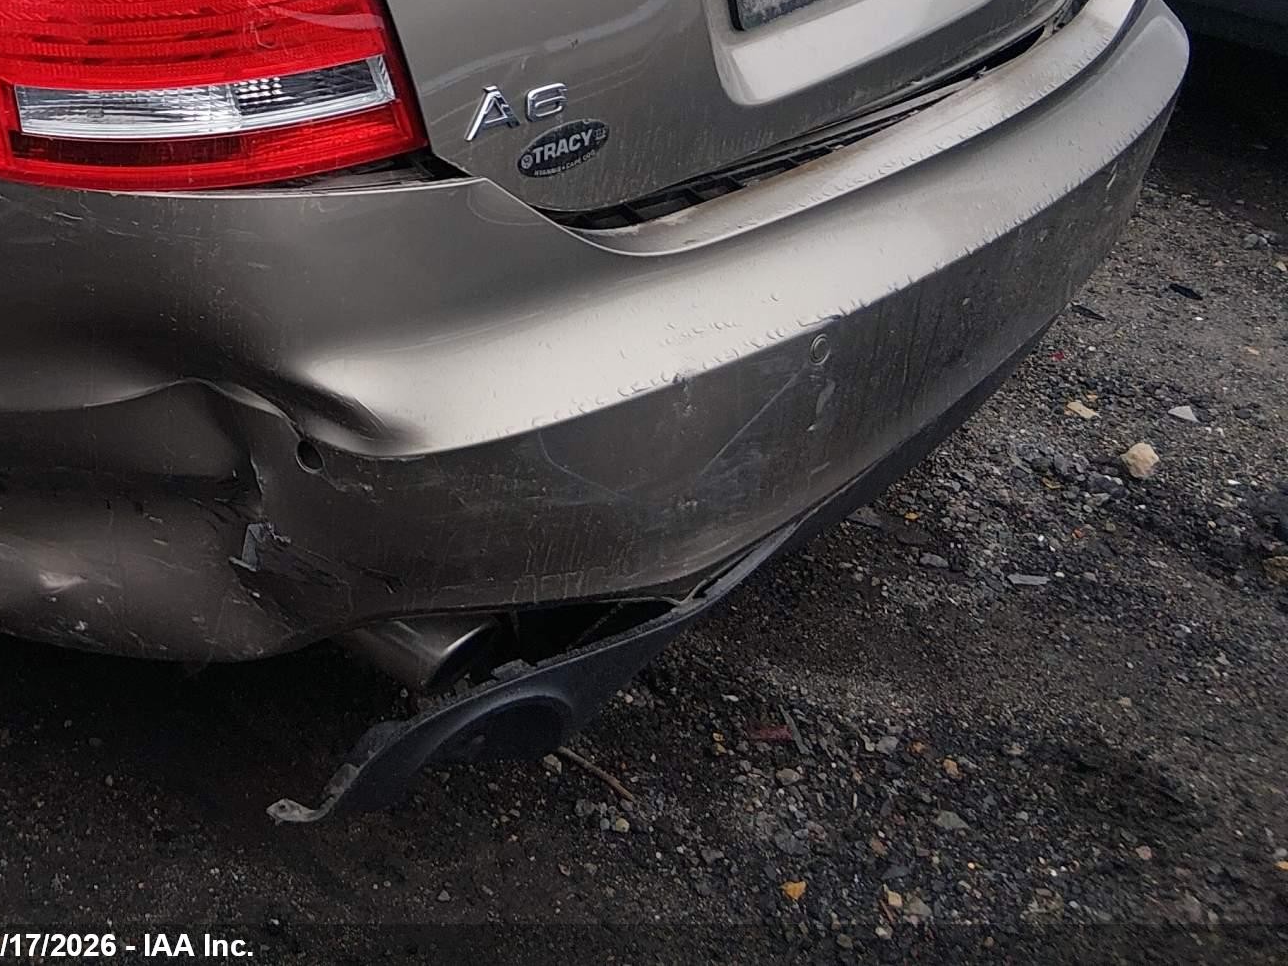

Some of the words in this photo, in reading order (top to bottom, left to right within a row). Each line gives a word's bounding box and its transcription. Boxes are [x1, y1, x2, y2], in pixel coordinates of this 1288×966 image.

[464, 82, 568, 143] A6
[532, 129, 593, 164] TRACY
[566, 159, 581, 170] CAPE
